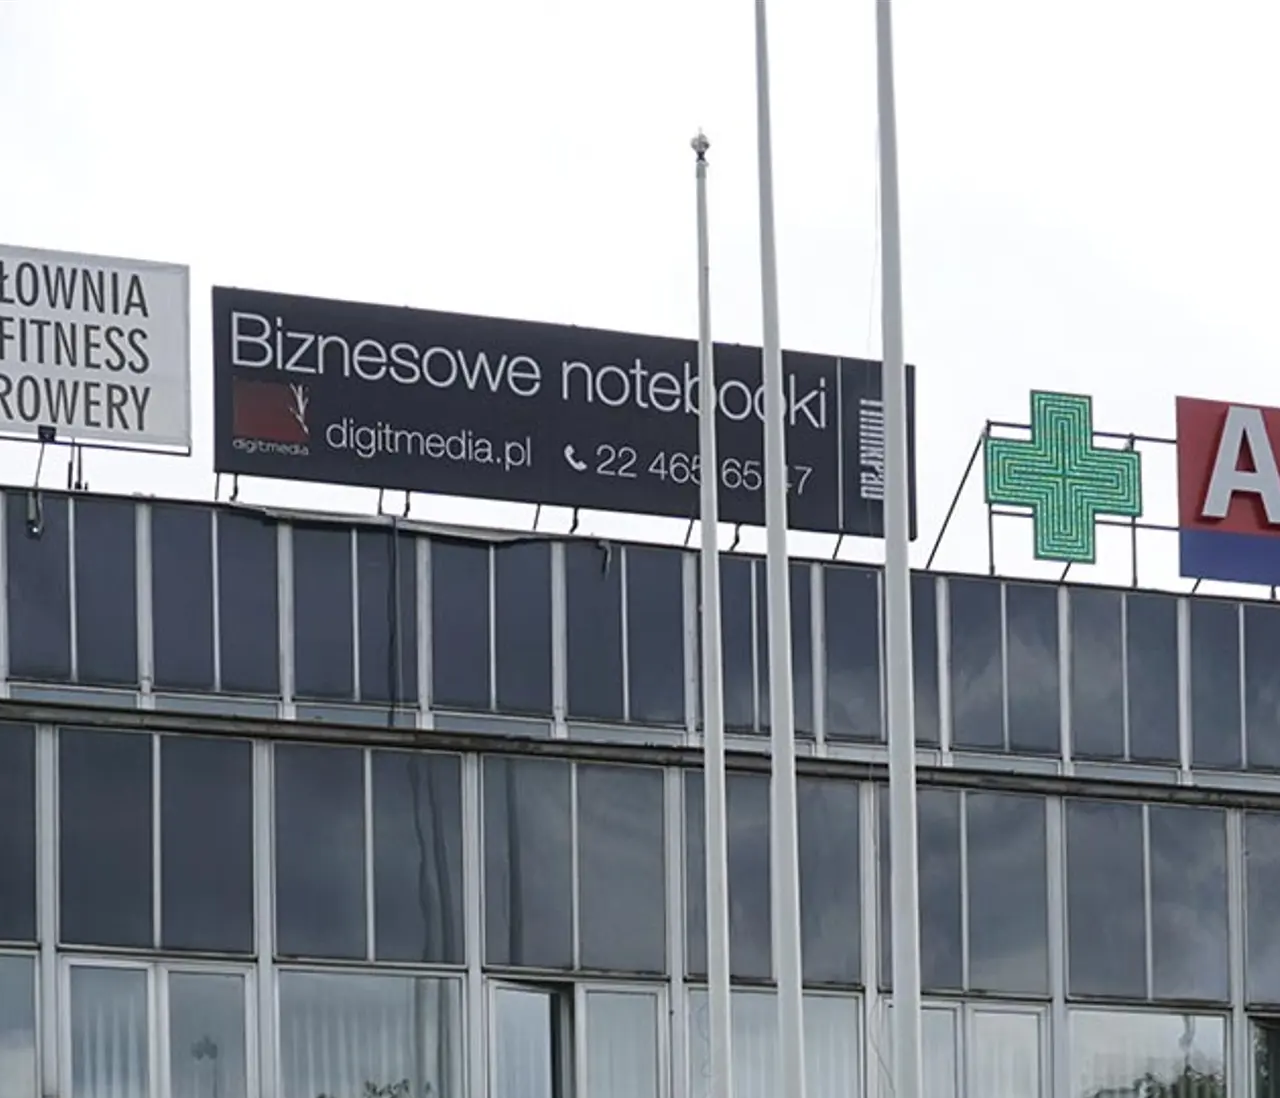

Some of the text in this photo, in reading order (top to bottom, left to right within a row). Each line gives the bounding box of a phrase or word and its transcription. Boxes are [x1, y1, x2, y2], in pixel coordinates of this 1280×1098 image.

[231, 310, 542, 397] Biznesowe
[325, 417, 532, 472] digitmedia.pl
[595, 444, 638, 478] 22
[648, 451, 705, 485] 465
